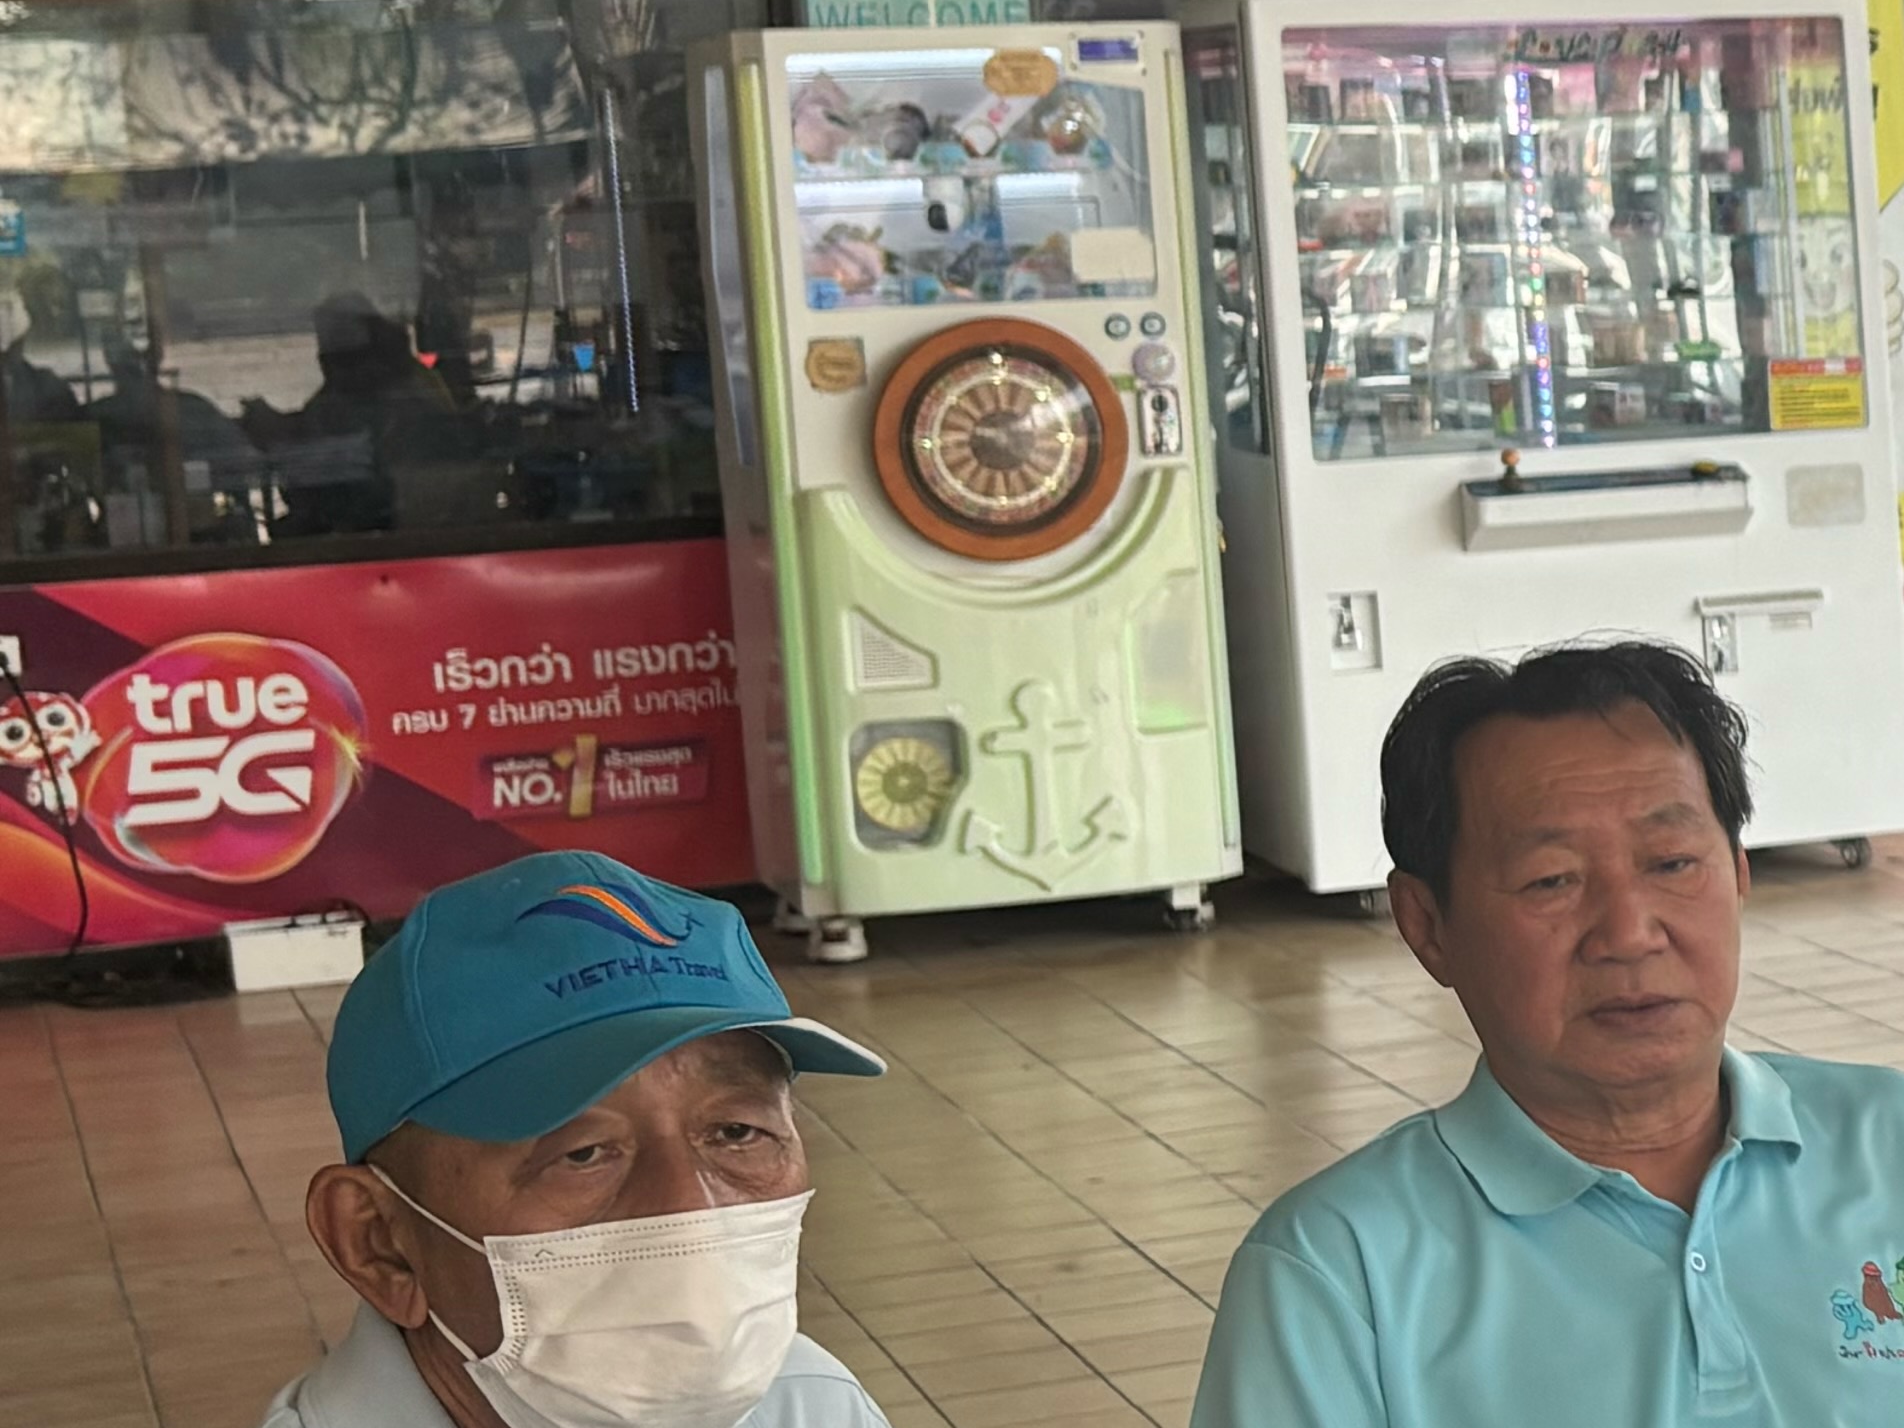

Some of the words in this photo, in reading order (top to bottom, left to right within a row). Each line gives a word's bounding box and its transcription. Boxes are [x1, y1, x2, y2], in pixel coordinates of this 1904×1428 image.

[432, 642, 573, 693] เร็วกว่า
[126, 673, 310, 734] true
[392, 709, 448, 736] ครบ
[458, 704, 477, 729] 7
[488, 687, 622, 727] ย่านความถี่
[122, 728, 316, 827] 5G
[604, 768, 680, 801] ในไทย
